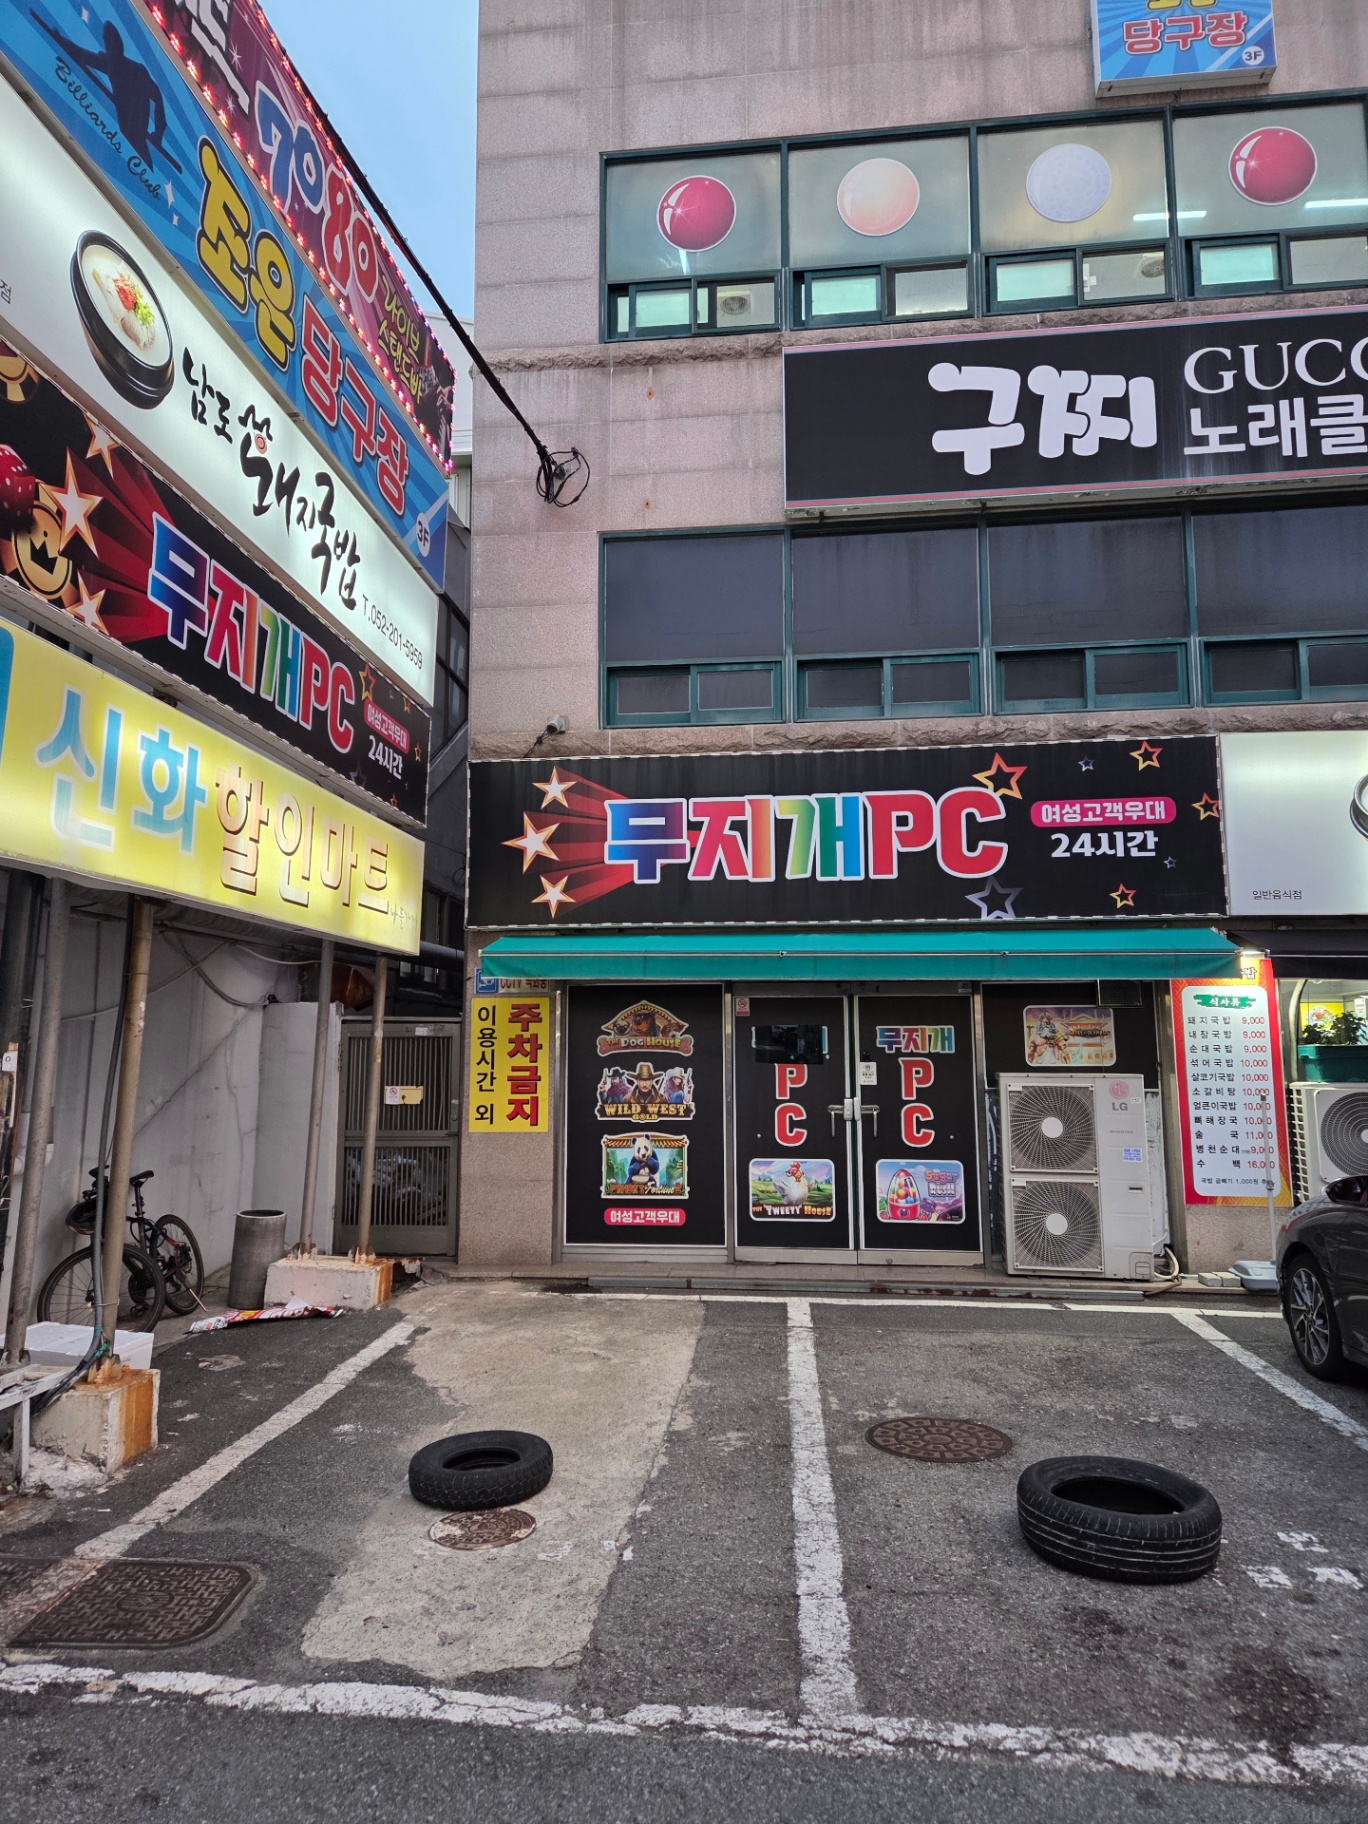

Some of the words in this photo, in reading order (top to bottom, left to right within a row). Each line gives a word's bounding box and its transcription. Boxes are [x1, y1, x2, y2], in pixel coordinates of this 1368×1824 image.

[1123, 10, 1248, 54] 당구장
[1244, 50, 1263, 61] 3F
[55, 56, 122, 153] Billiards
[127, 156, 161, 199] Club
[382, 275, 420, 364] 라이브
[302, 291, 409, 516] 당구장
[928, 362, 1157, 476] 구찌
[417, 520, 429, 547] 3F
[148, 511, 356, 754] 무지개PC
[362, 594, 422, 670] T.052-201-5959
[367, 703, 407, 750] 여성고객우대
[368, 734, 404, 780] 24시간
[34, 682, 208, 858] 신화
[215, 763, 389, 915] 할인마트
[1041, 800, 1166, 824] 여성고객우대
[603, 787, 1009, 885] 무지개PC
[1050, 829, 1159, 858] 24시간
[1252, 889, 1303, 900] 일반음식점
[1242, 1016, 1266, 1025] 9,000
[876, 1025, 956, 1054] 무지개
[1243, 1030, 1267, 1039] 9,000
[476, 1004, 498, 1093] 이용시간
[1244, 1045, 1268, 1054] 9,000
[506, 1003, 543, 1127] 주차금지
[1240, 1059, 1269, 1068] 10,000
[1241, 1073, 1270, 1082] 10,000
[1242, 1088, 1270, 1096] 10,000
[604, 1104, 642, 1116] WILD
[646, 1104, 687, 1116] WEST
[1112, 1102, 1128, 1111] LG
[1243, 1102, 1271, 1111] 10,00
[1244, 1116, 1273, 1125] 10,00
[1245, 1131, 1274, 1140] 11,00
[1250, 1145, 1275, 1155] 9,00
[1247, 1160, 1276, 1169] 16,00
[610, 1210, 680, 1224] 여성고객우대
